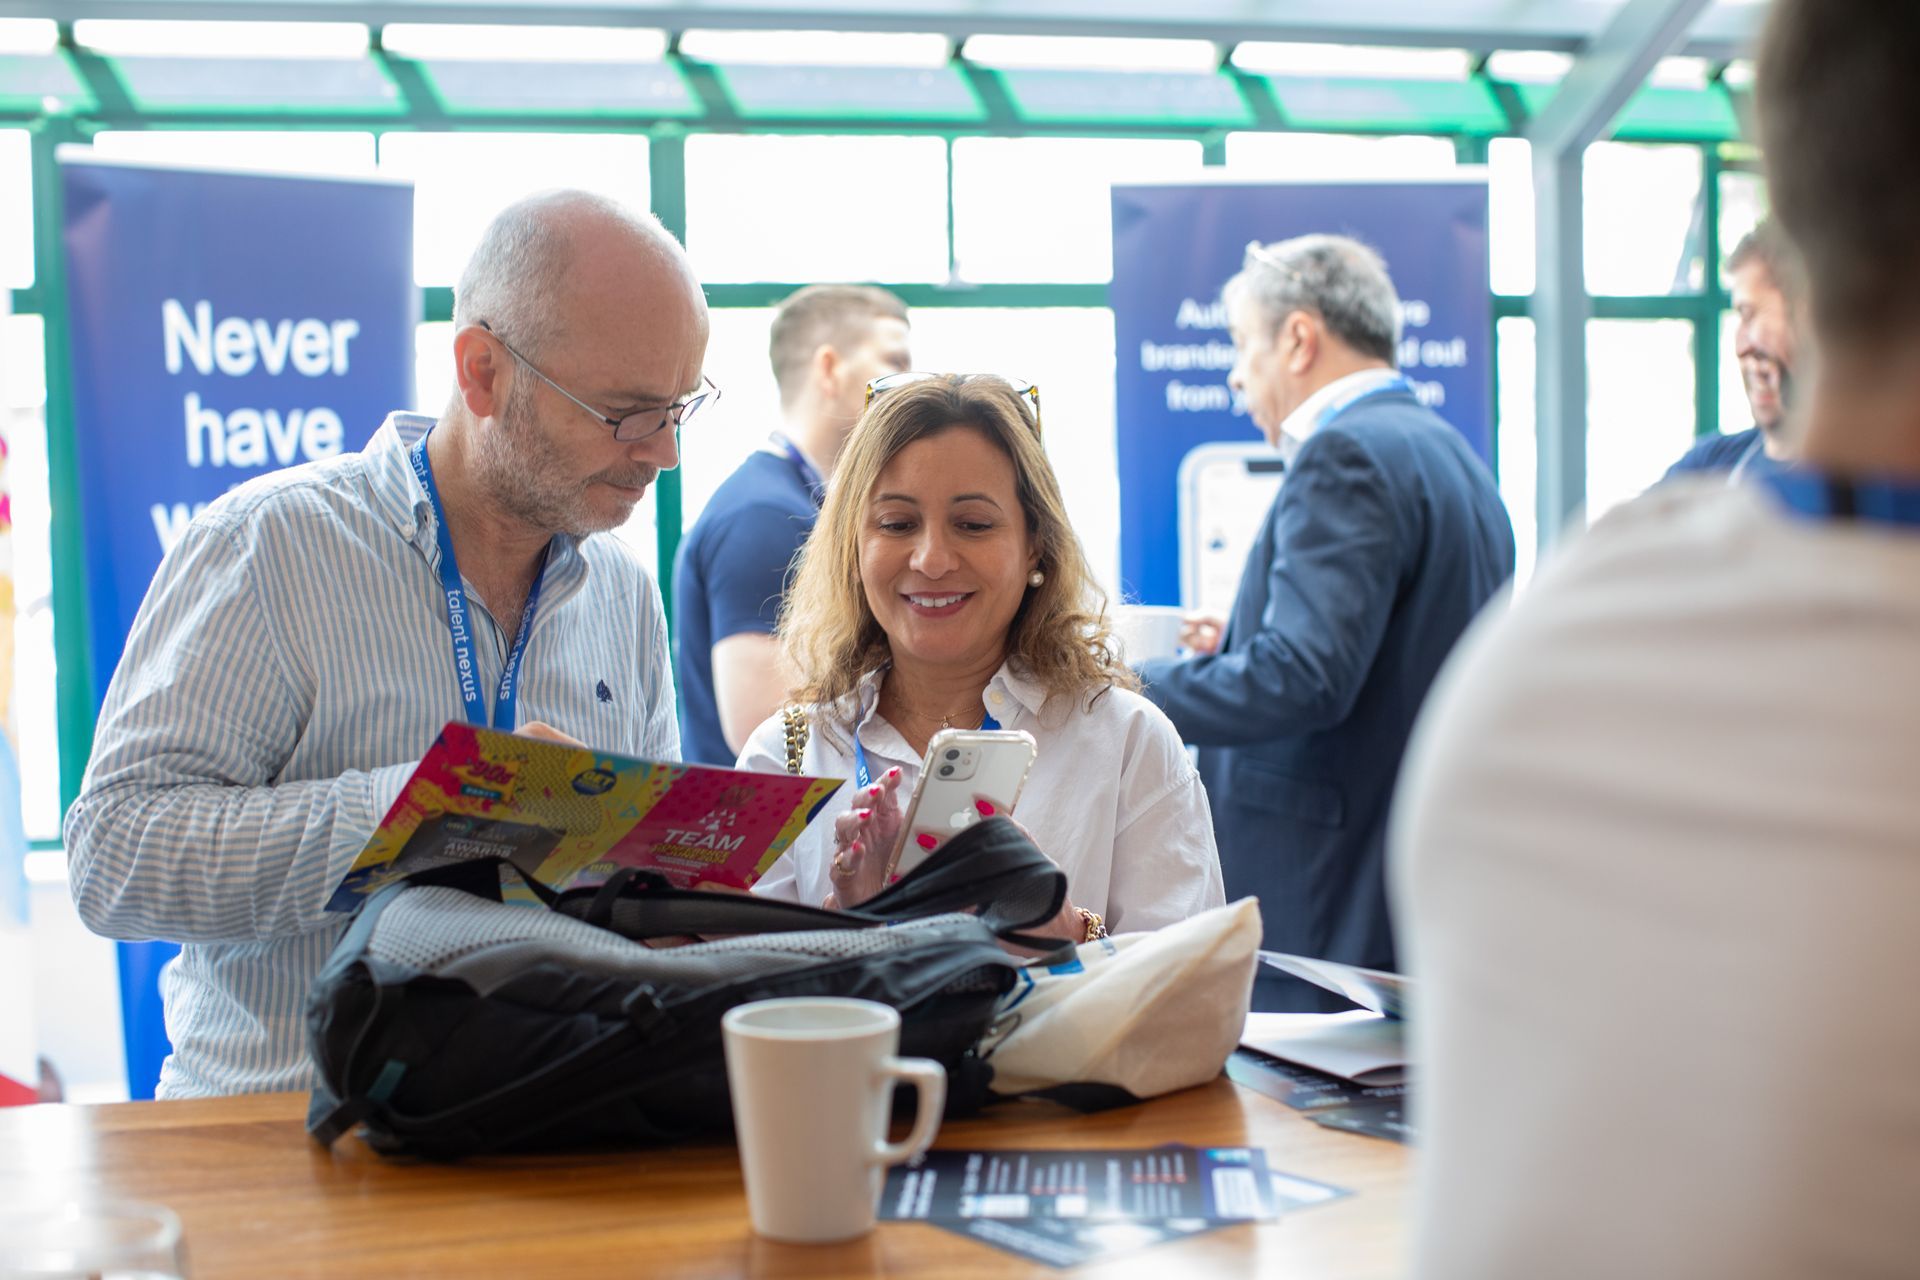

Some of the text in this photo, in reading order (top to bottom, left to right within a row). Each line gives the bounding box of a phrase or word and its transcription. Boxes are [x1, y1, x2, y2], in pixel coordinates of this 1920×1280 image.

[162, 299, 359, 376] Never
[184, 392, 344, 467] have
[412, 440, 428, 477] alent
[447, 589, 476, 702] talent nexus
[500, 602, 535, 700] talent nexus
[663, 829, 746, 851] TEAM
